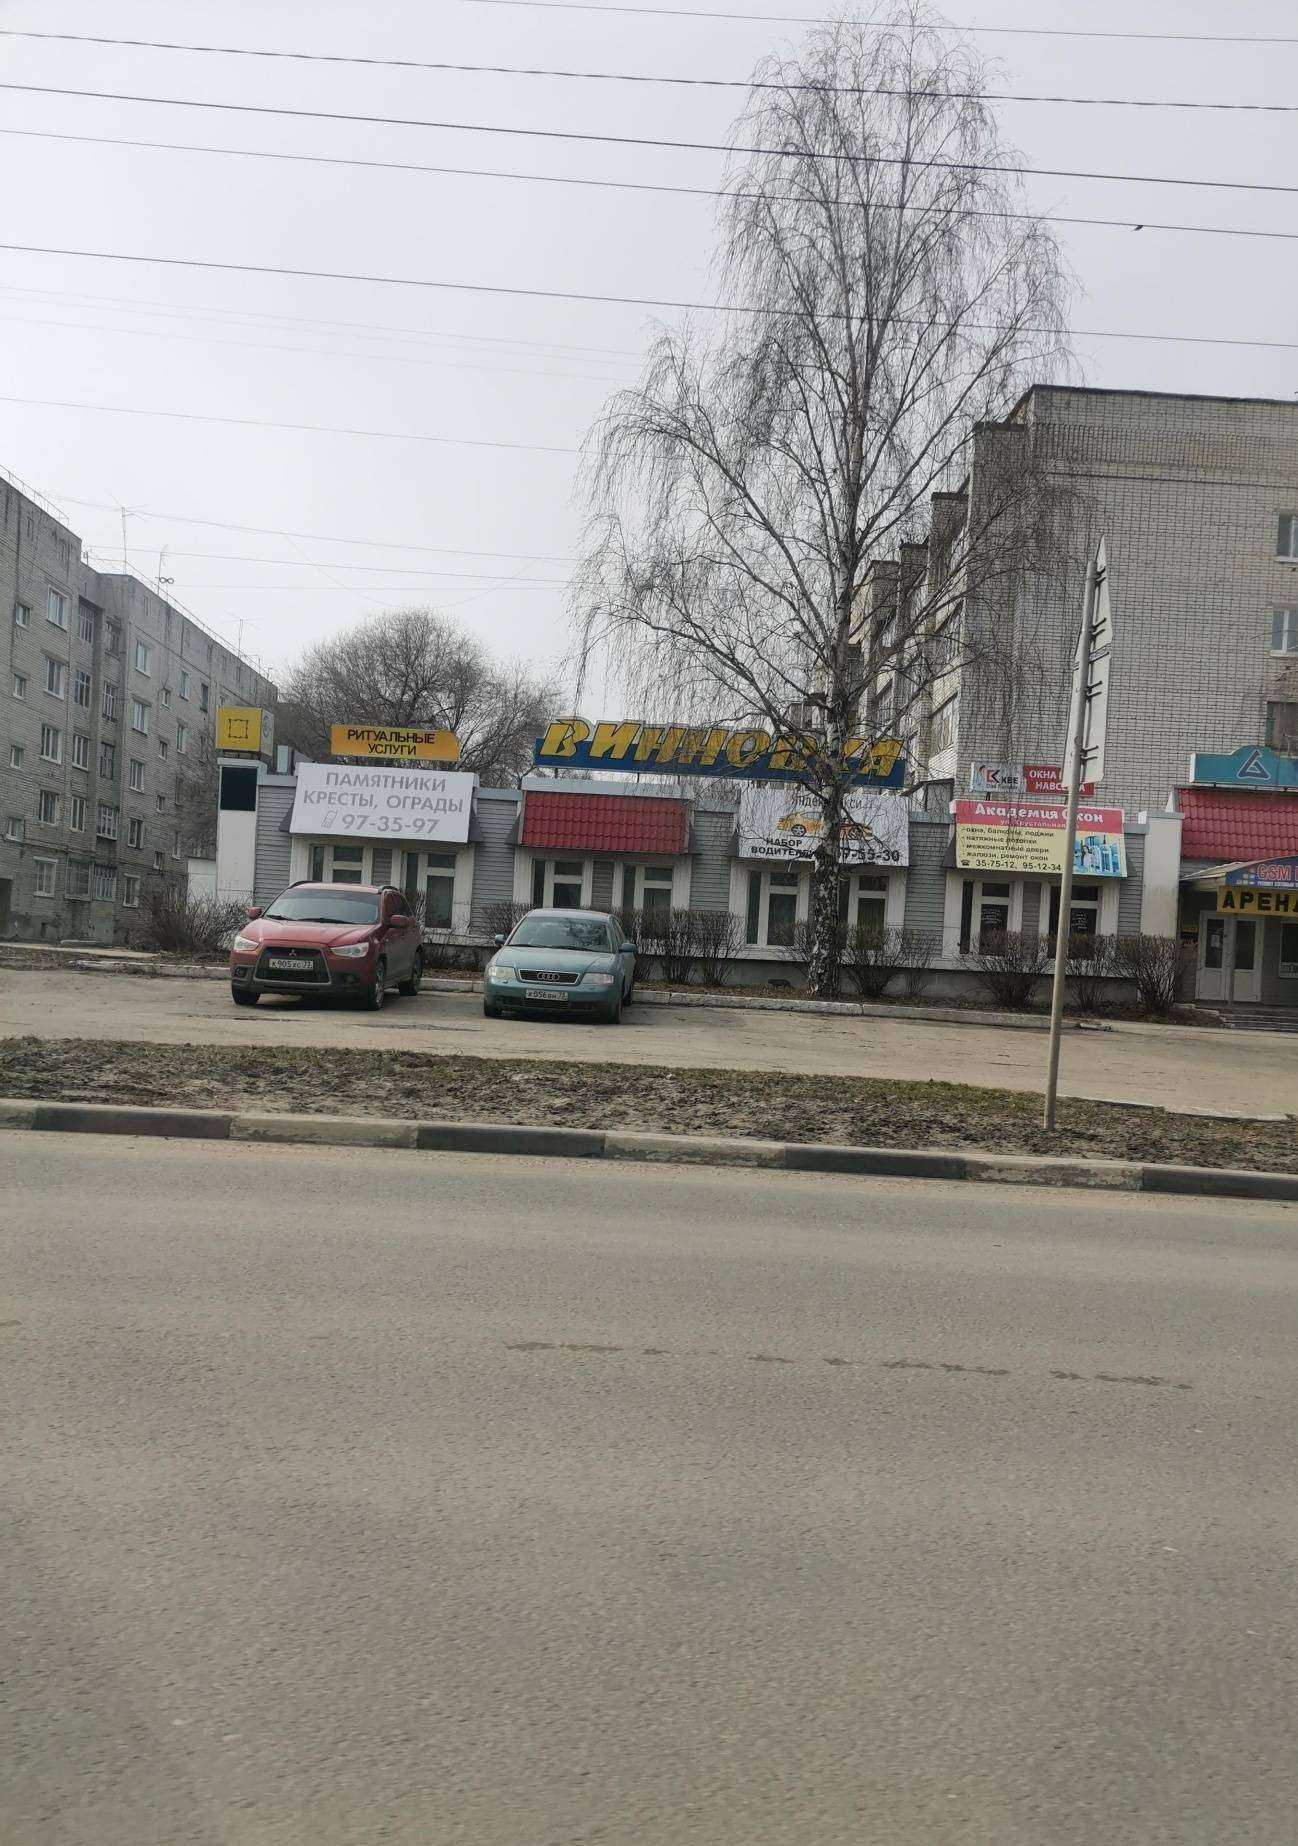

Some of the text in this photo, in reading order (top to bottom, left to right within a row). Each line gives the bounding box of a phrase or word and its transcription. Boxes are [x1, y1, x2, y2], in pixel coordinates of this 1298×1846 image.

[347, 729, 436, 744] РИТУАЛЬНЫЕ
[368, 743, 417, 756] УСЛУГИ
[326, 772, 448, 792] ПАМЯТНИКИ
[1029, 769, 1057, 780] ОКНА
[1035, 781, 1086, 792] НАВСЕА
[303, 790, 464, 813] КРЕСТЫ, ОГРАДЫ
[975, 803, 1059, 819] Академия
[342, 814, 440, 834] 97-35-97
[766, 837, 803, 848] НАБОР
[1022, 862, 1062, 871] 95-12-34
[1256, 863, 1292, 881] GSM
